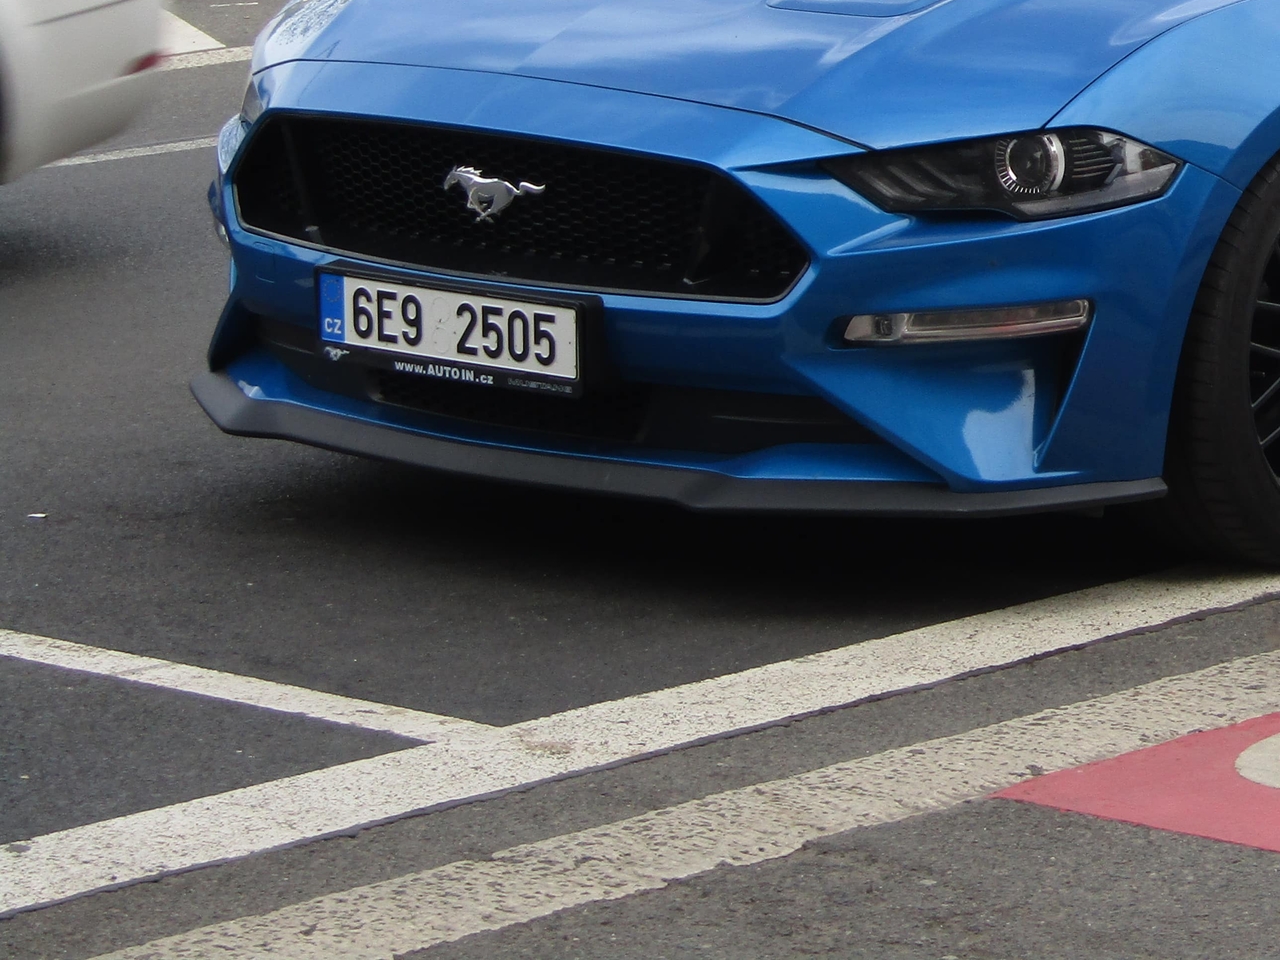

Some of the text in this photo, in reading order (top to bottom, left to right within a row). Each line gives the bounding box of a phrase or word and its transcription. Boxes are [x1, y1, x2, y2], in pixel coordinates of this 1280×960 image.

[324, 318, 342, 335] CZ
[352, 287, 556, 366] 6E9 2505
